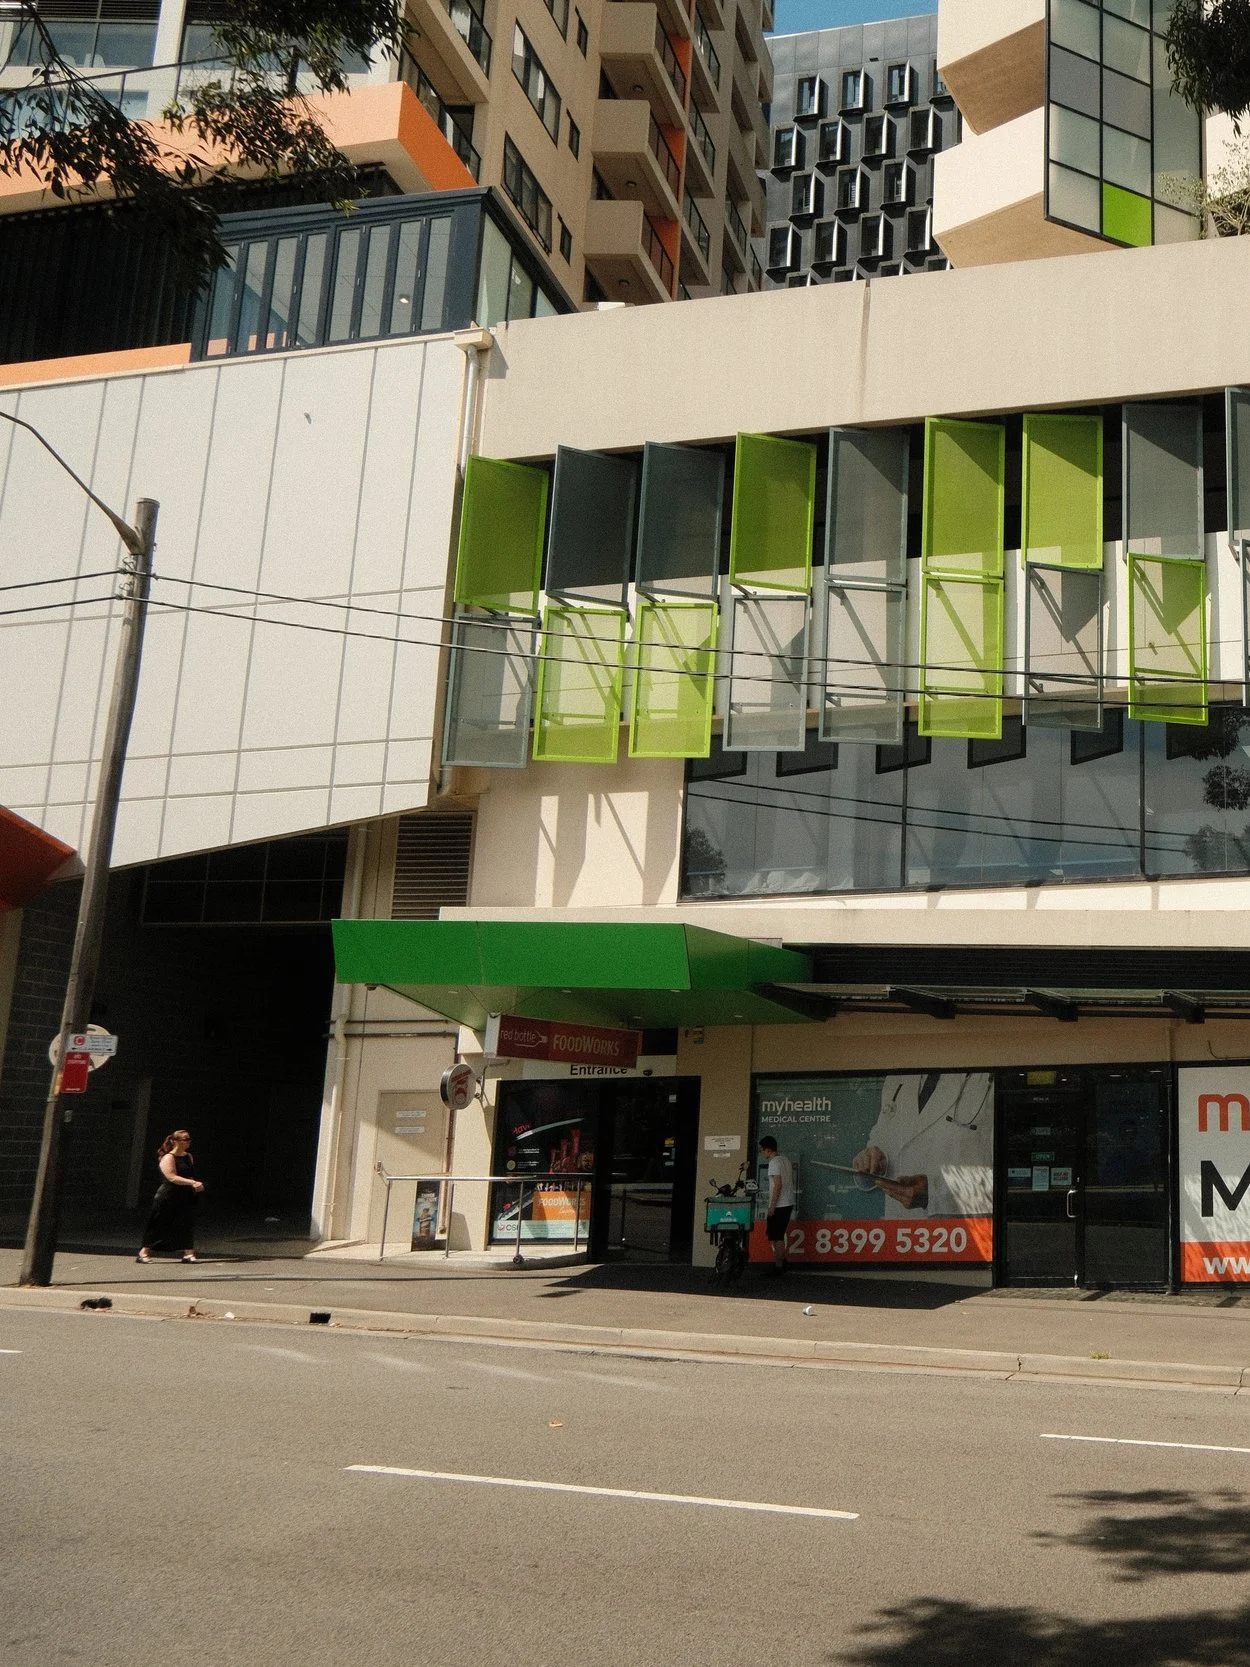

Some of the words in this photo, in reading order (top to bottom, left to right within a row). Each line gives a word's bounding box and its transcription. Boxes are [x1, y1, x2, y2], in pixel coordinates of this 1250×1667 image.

[500, 1029, 513, 1040] red
[514, 1029, 536, 1043] bottle
[761, 1096, 832, 1116] myhealth
[761, 1115, 798, 1123] MEDICAL
[799, 1115, 832, 1123] CENTRE
[815, 1228, 886, 1254] 8399
[895, 1227, 968, 1254] 5320
